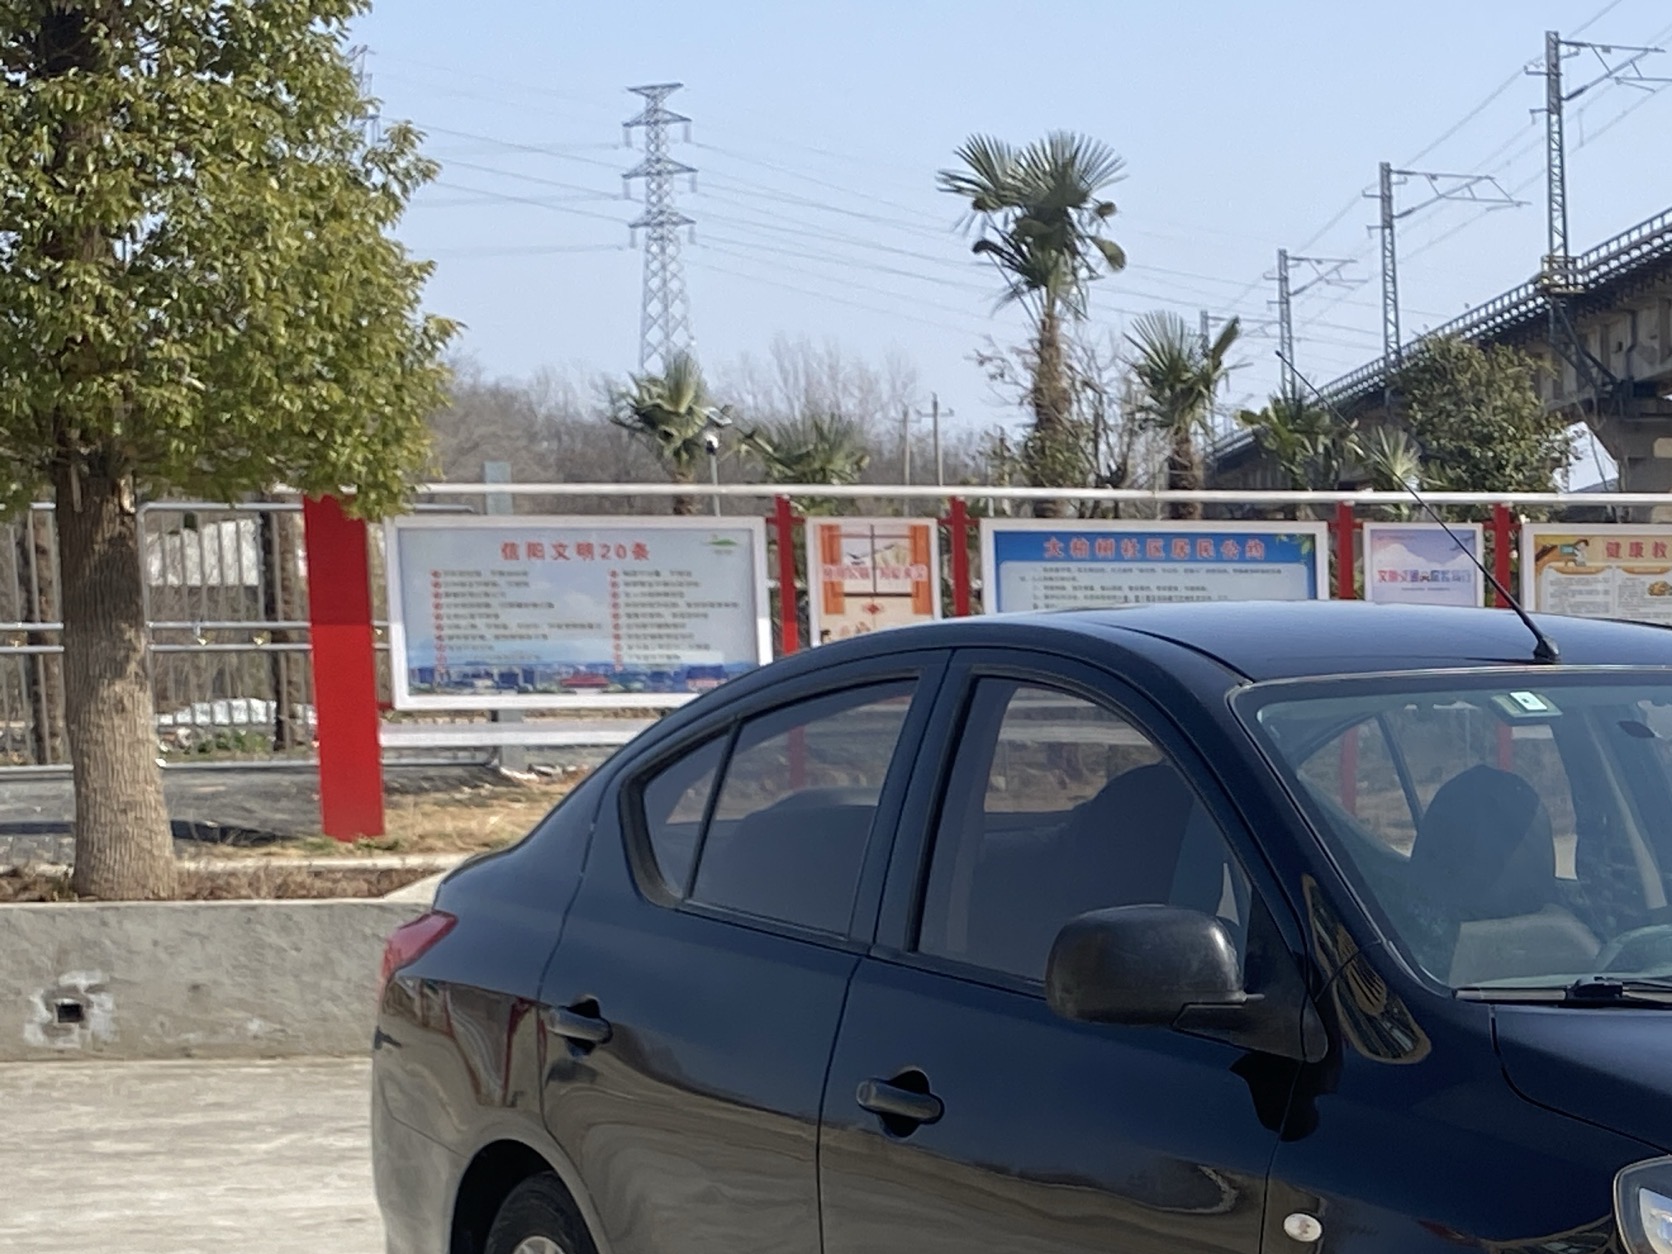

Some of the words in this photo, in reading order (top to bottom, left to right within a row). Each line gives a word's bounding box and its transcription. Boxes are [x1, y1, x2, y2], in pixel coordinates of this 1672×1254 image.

[500, 540, 651, 562] 信阳文明20条
